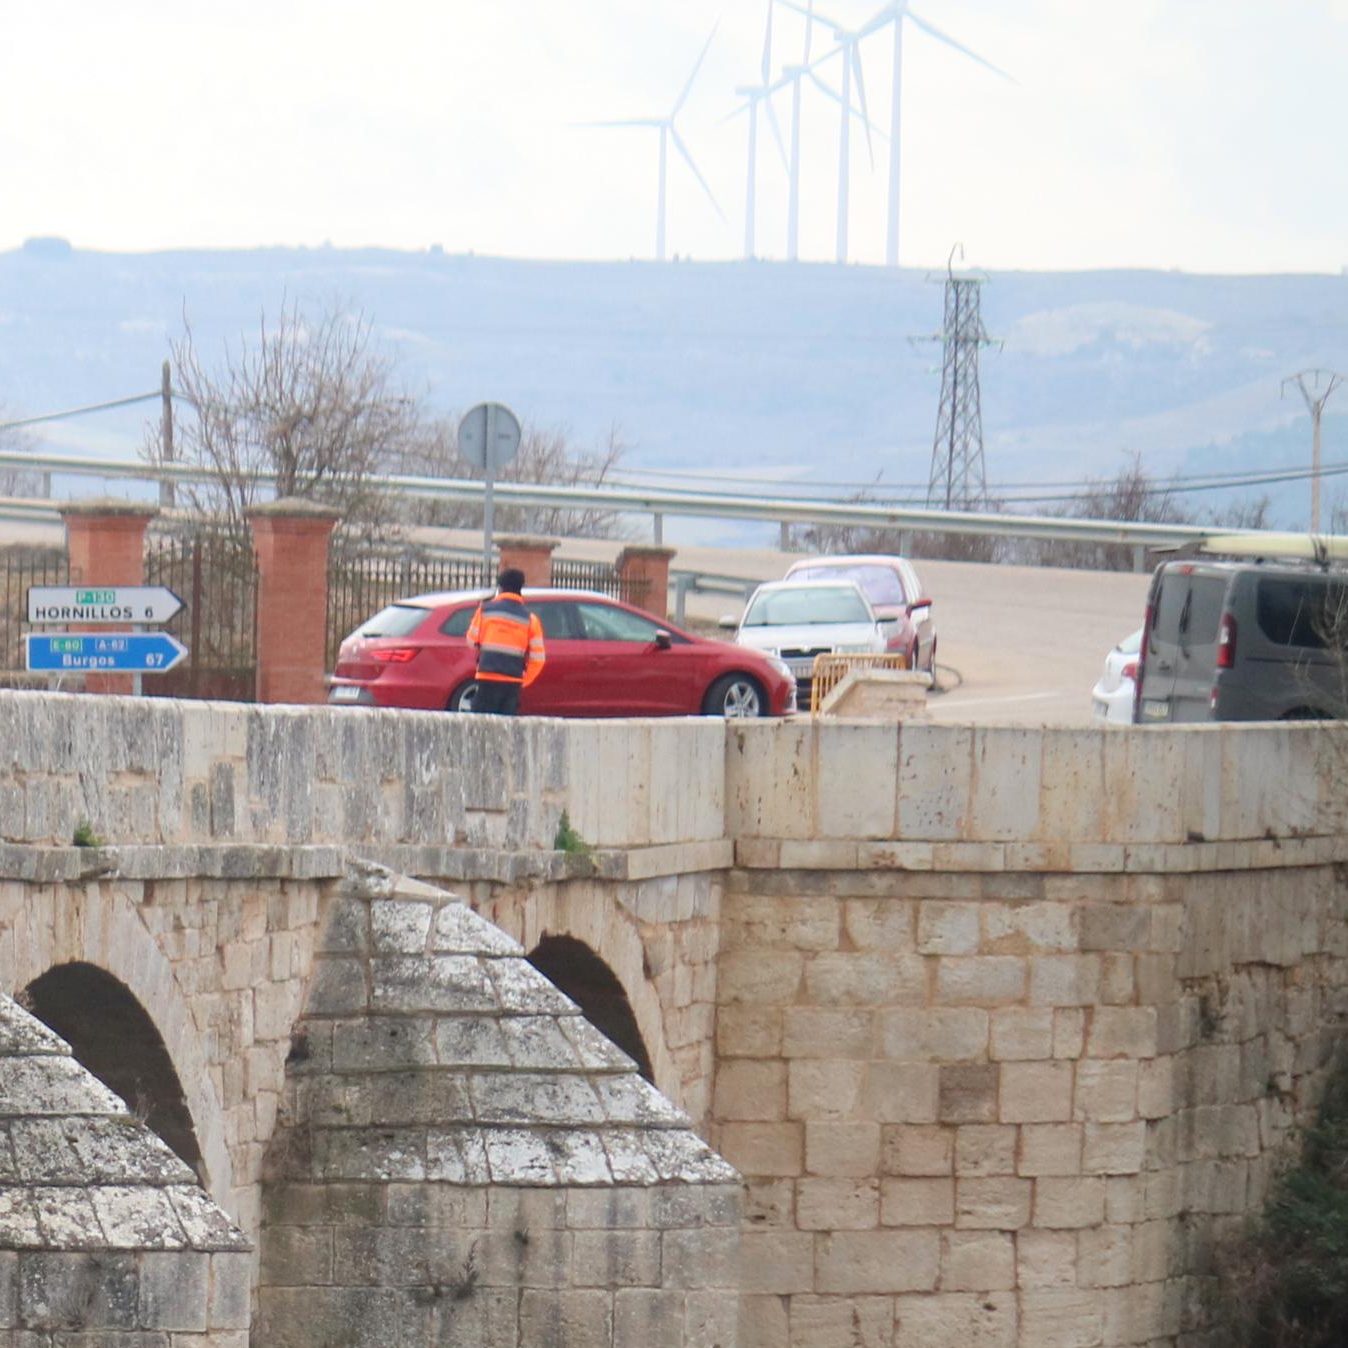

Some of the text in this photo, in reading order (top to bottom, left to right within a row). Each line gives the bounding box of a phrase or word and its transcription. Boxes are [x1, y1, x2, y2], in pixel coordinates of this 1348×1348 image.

[35, 607, 154, 619] HORNILLOS 6
[62, 653, 164, 668] Burgos 67
